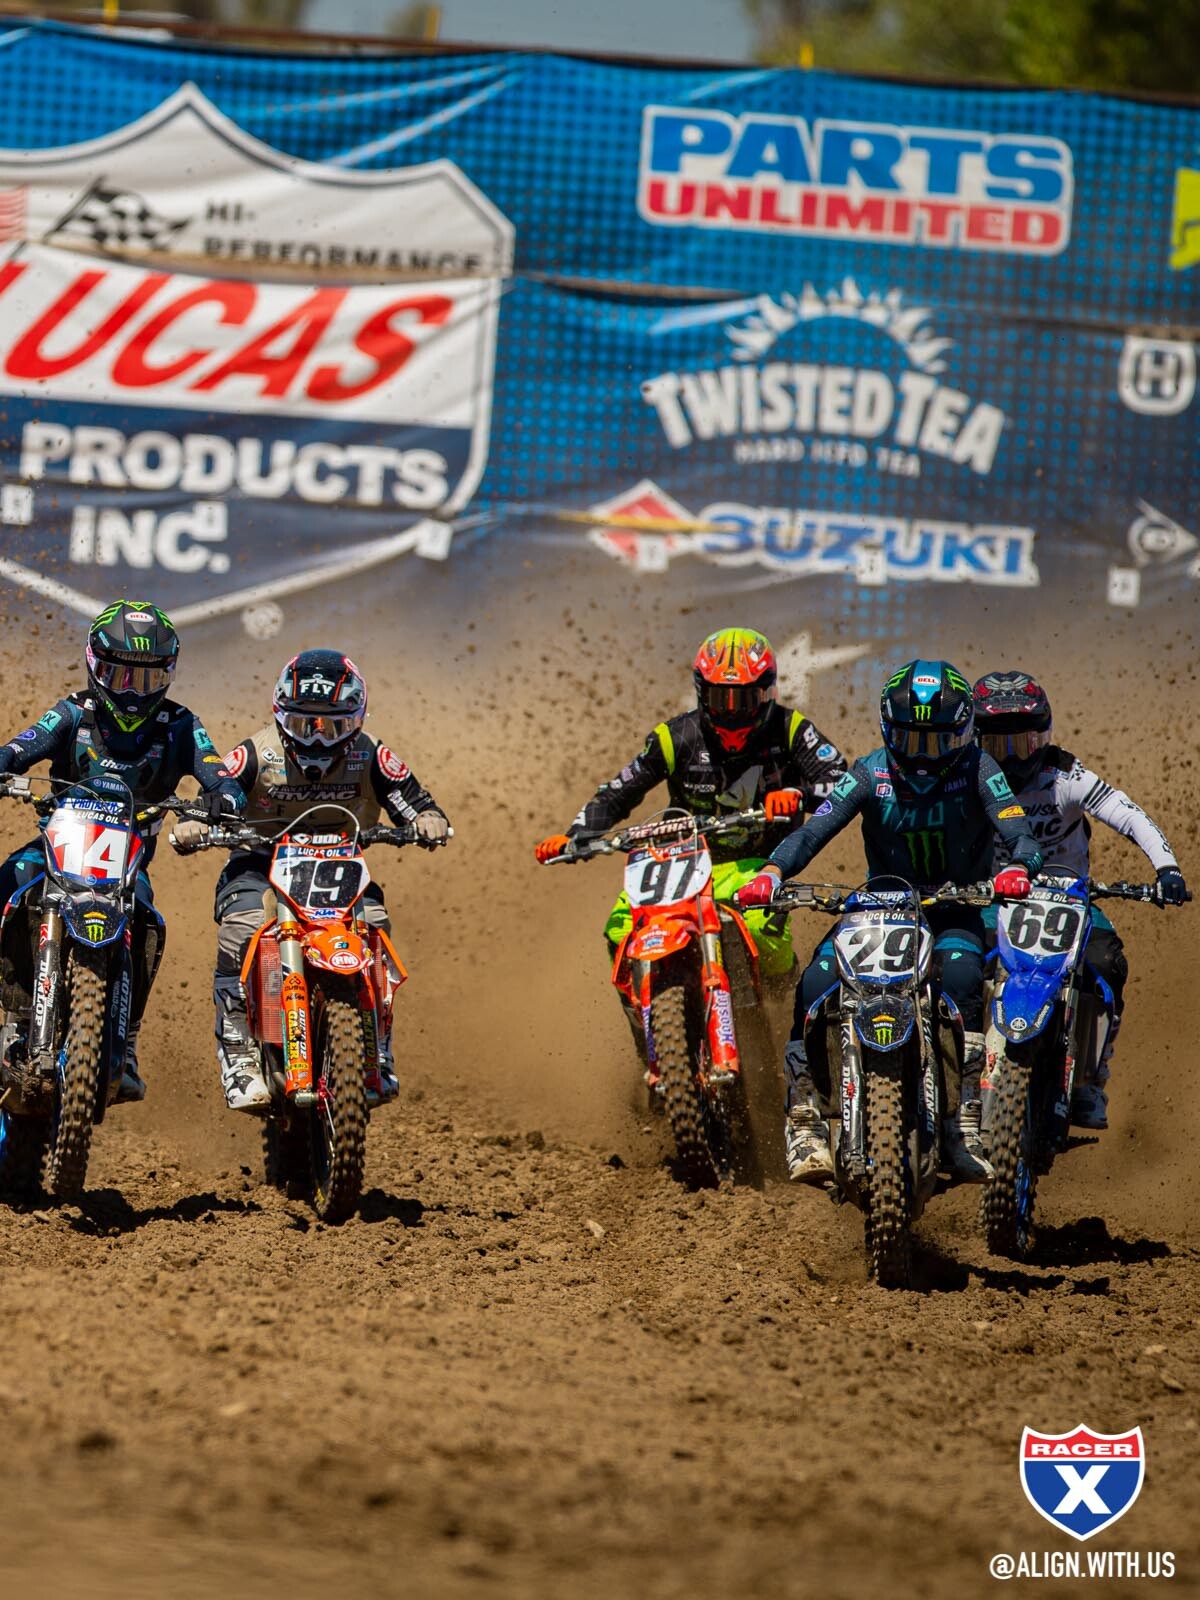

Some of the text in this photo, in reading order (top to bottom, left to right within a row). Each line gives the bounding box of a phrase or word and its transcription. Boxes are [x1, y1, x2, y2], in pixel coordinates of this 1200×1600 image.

[648, 112, 1067, 204] PARTS
[204, 199, 256, 223] HI-
[644, 176, 1064, 250] UNLIMITED
[640, 362, 1006, 476] TWISTED TEA
[19, 421, 452, 511] PRODUCTS
[68, 506, 230, 573] INC.
[699, 508, 1030, 581] SUZUKI
[129, 612, 151, 620] BELL
[299, 683, 333, 695] FLY
[917, 676, 937, 684] BELL
[99, 758, 133, 772] thor
[76, 811, 120, 824] LUCAS OIL
[52, 820, 129, 880] 14
[297, 847, 341, 857] LUCAS OIL
[286, 860, 363, 908] 19
[639, 855, 703, 906] 97
[1052, 893, 1068, 902] OIL
[862, 912, 906, 921] LUCAS OIL
[1007, 904, 1081, 951] 69
[849, 926, 918, 973] 29
[35, 959, 48, 1027] DUNLOP
[117, 970, 131, 1041] DUNLOP
[842, 1066, 851, 1132] DUNLOP
[926, 1067, 936, 1134] DUNLOP
